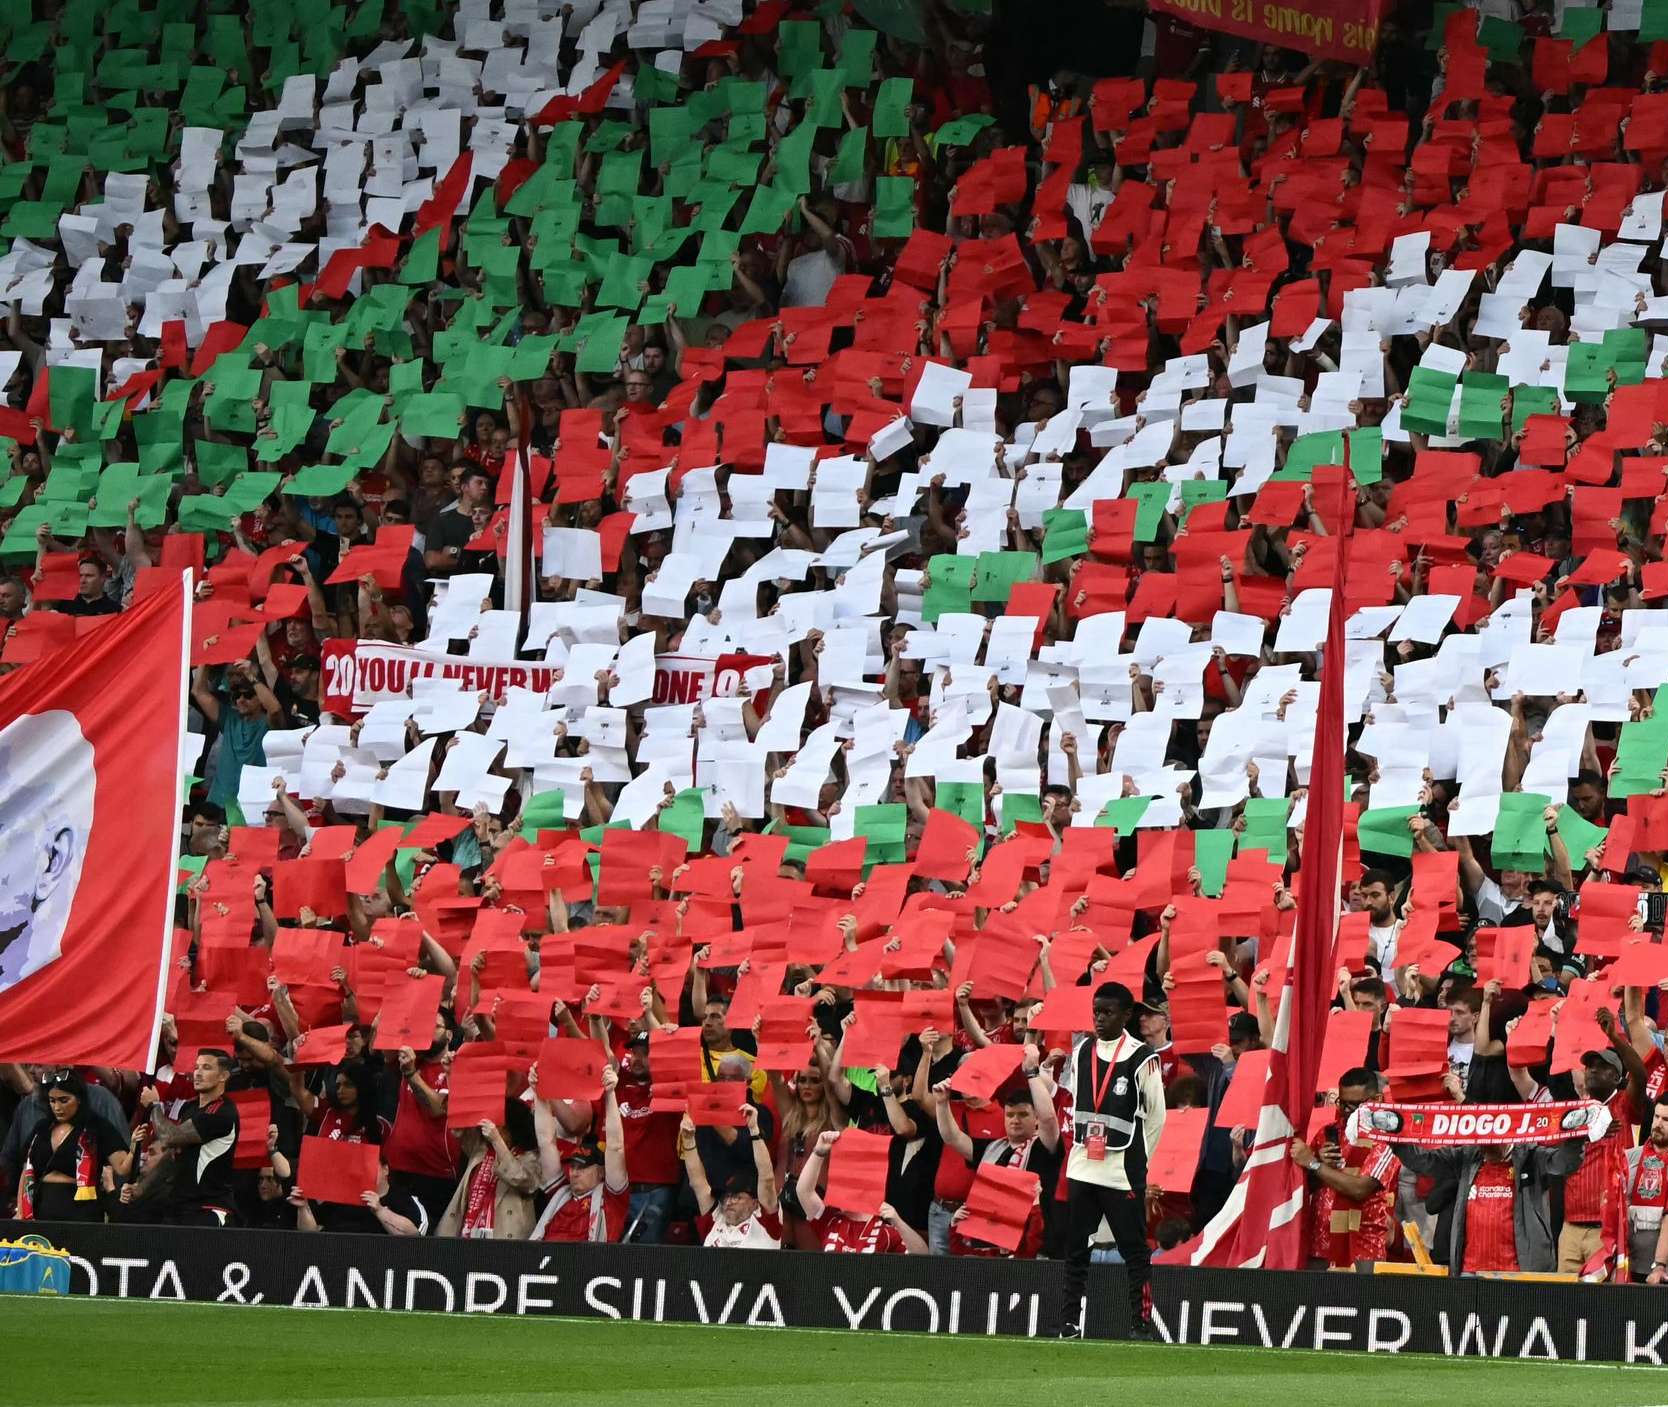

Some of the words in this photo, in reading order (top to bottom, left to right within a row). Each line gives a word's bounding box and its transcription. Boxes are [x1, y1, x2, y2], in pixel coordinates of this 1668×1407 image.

[326, 654, 355, 696] 20
[651, 669, 706, 705] ONE
[1431, 1113, 1512, 1136] DIOGO
[1516, 1112, 1536, 1135] J.
[1536, 1117, 1549, 1128] 20
[69, 1255, 187, 1301] OTA
[216, 1261, 264, 1304] &
[293, 1255, 558, 1315] ANDRÉ
[584, 1275, 786, 1327] SILVA
[1150, 1299, 1411, 1353] NEVER
